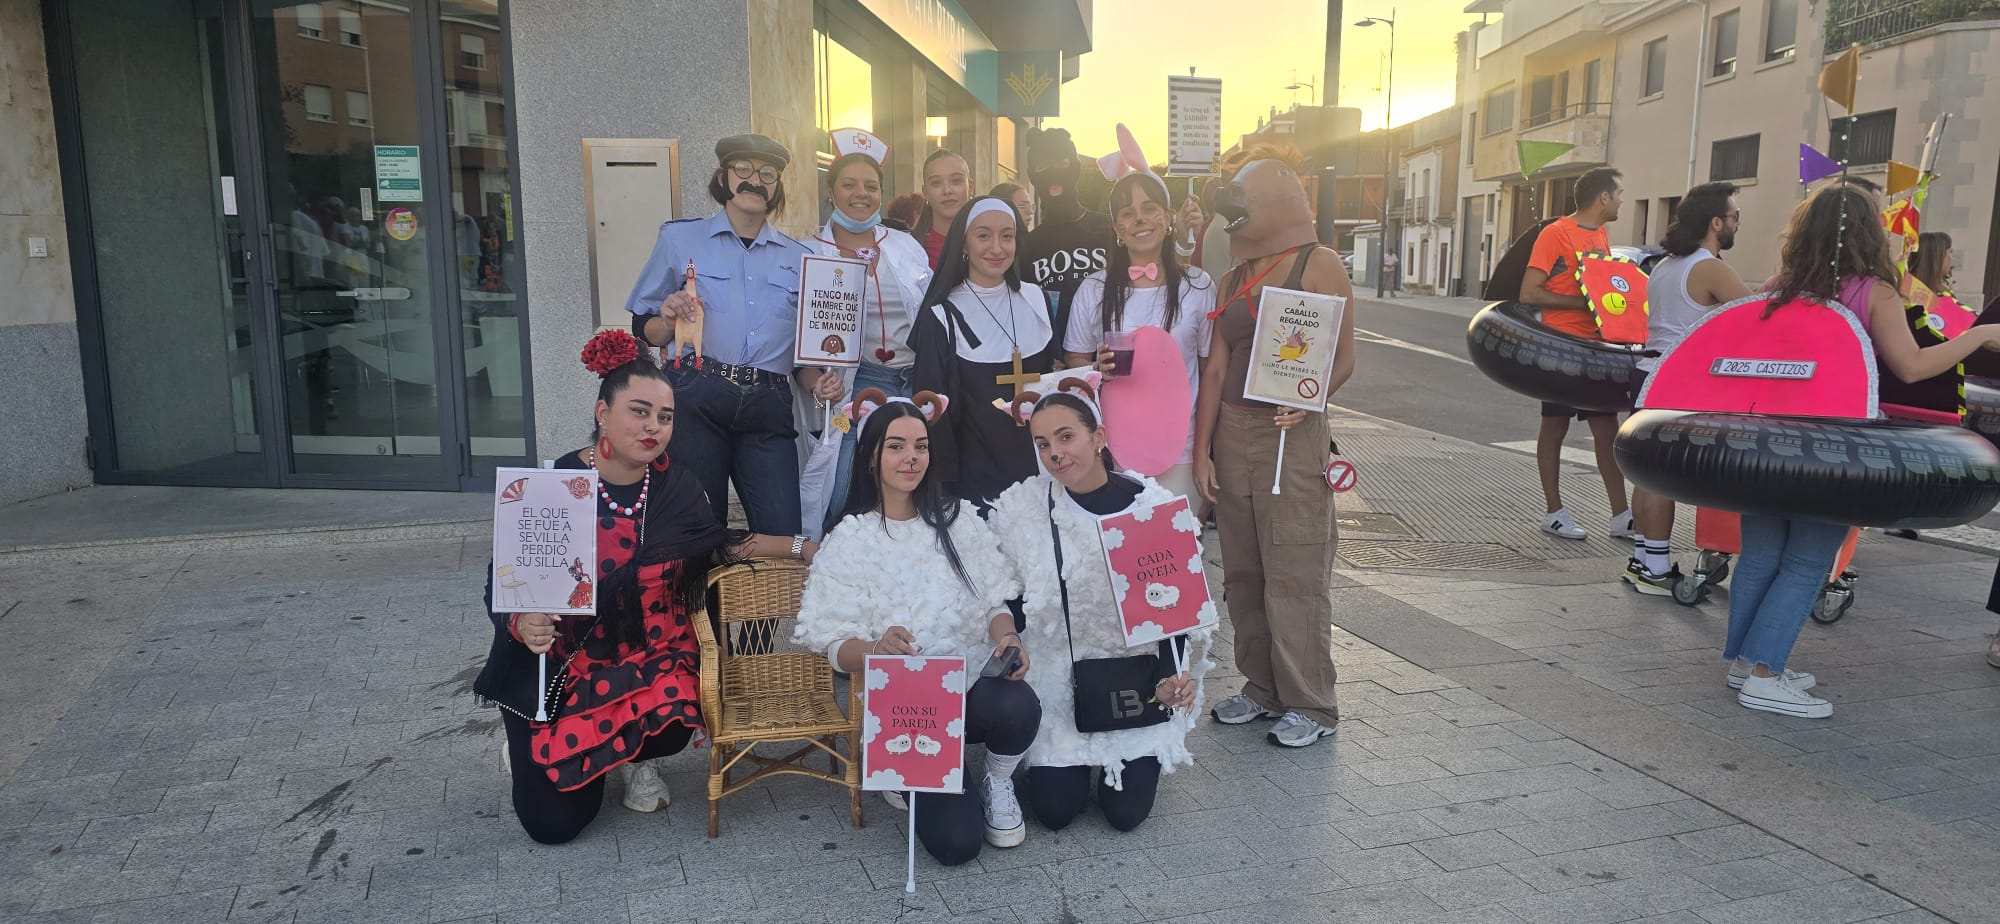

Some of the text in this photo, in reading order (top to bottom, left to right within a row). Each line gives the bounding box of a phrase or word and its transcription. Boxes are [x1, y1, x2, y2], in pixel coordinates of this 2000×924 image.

[1032, 248, 1107, 282] BOSS
[813, 290, 841, 300] TENGO
[811, 300, 859, 312] HAMBRE QUE
[1298, 299, 1305, 307] A
[813, 310, 856, 322] LOS PAVOS
[1284, 307, 1318, 319] CABALLO
[809, 321, 856, 332] DE MANOLO
[1279, 316, 1320, 328] REGALADO
[1290, 366, 1309, 374] MIRES
[1723, 361, 1809, 376] 2025 CASTIZOS
[522, 507, 569, 519] EL QUE
[517, 519, 572, 531] SE FUE A
[519, 532, 570, 543] SEVILLA
[516, 556, 569, 568] SU SILLA
[1137, 549, 1174, 567] CADA
[1136, 563, 1178, 582] OVEJA
[892, 706, 937, 717] CON SU
[891, 718, 937, 730] PAREJA
